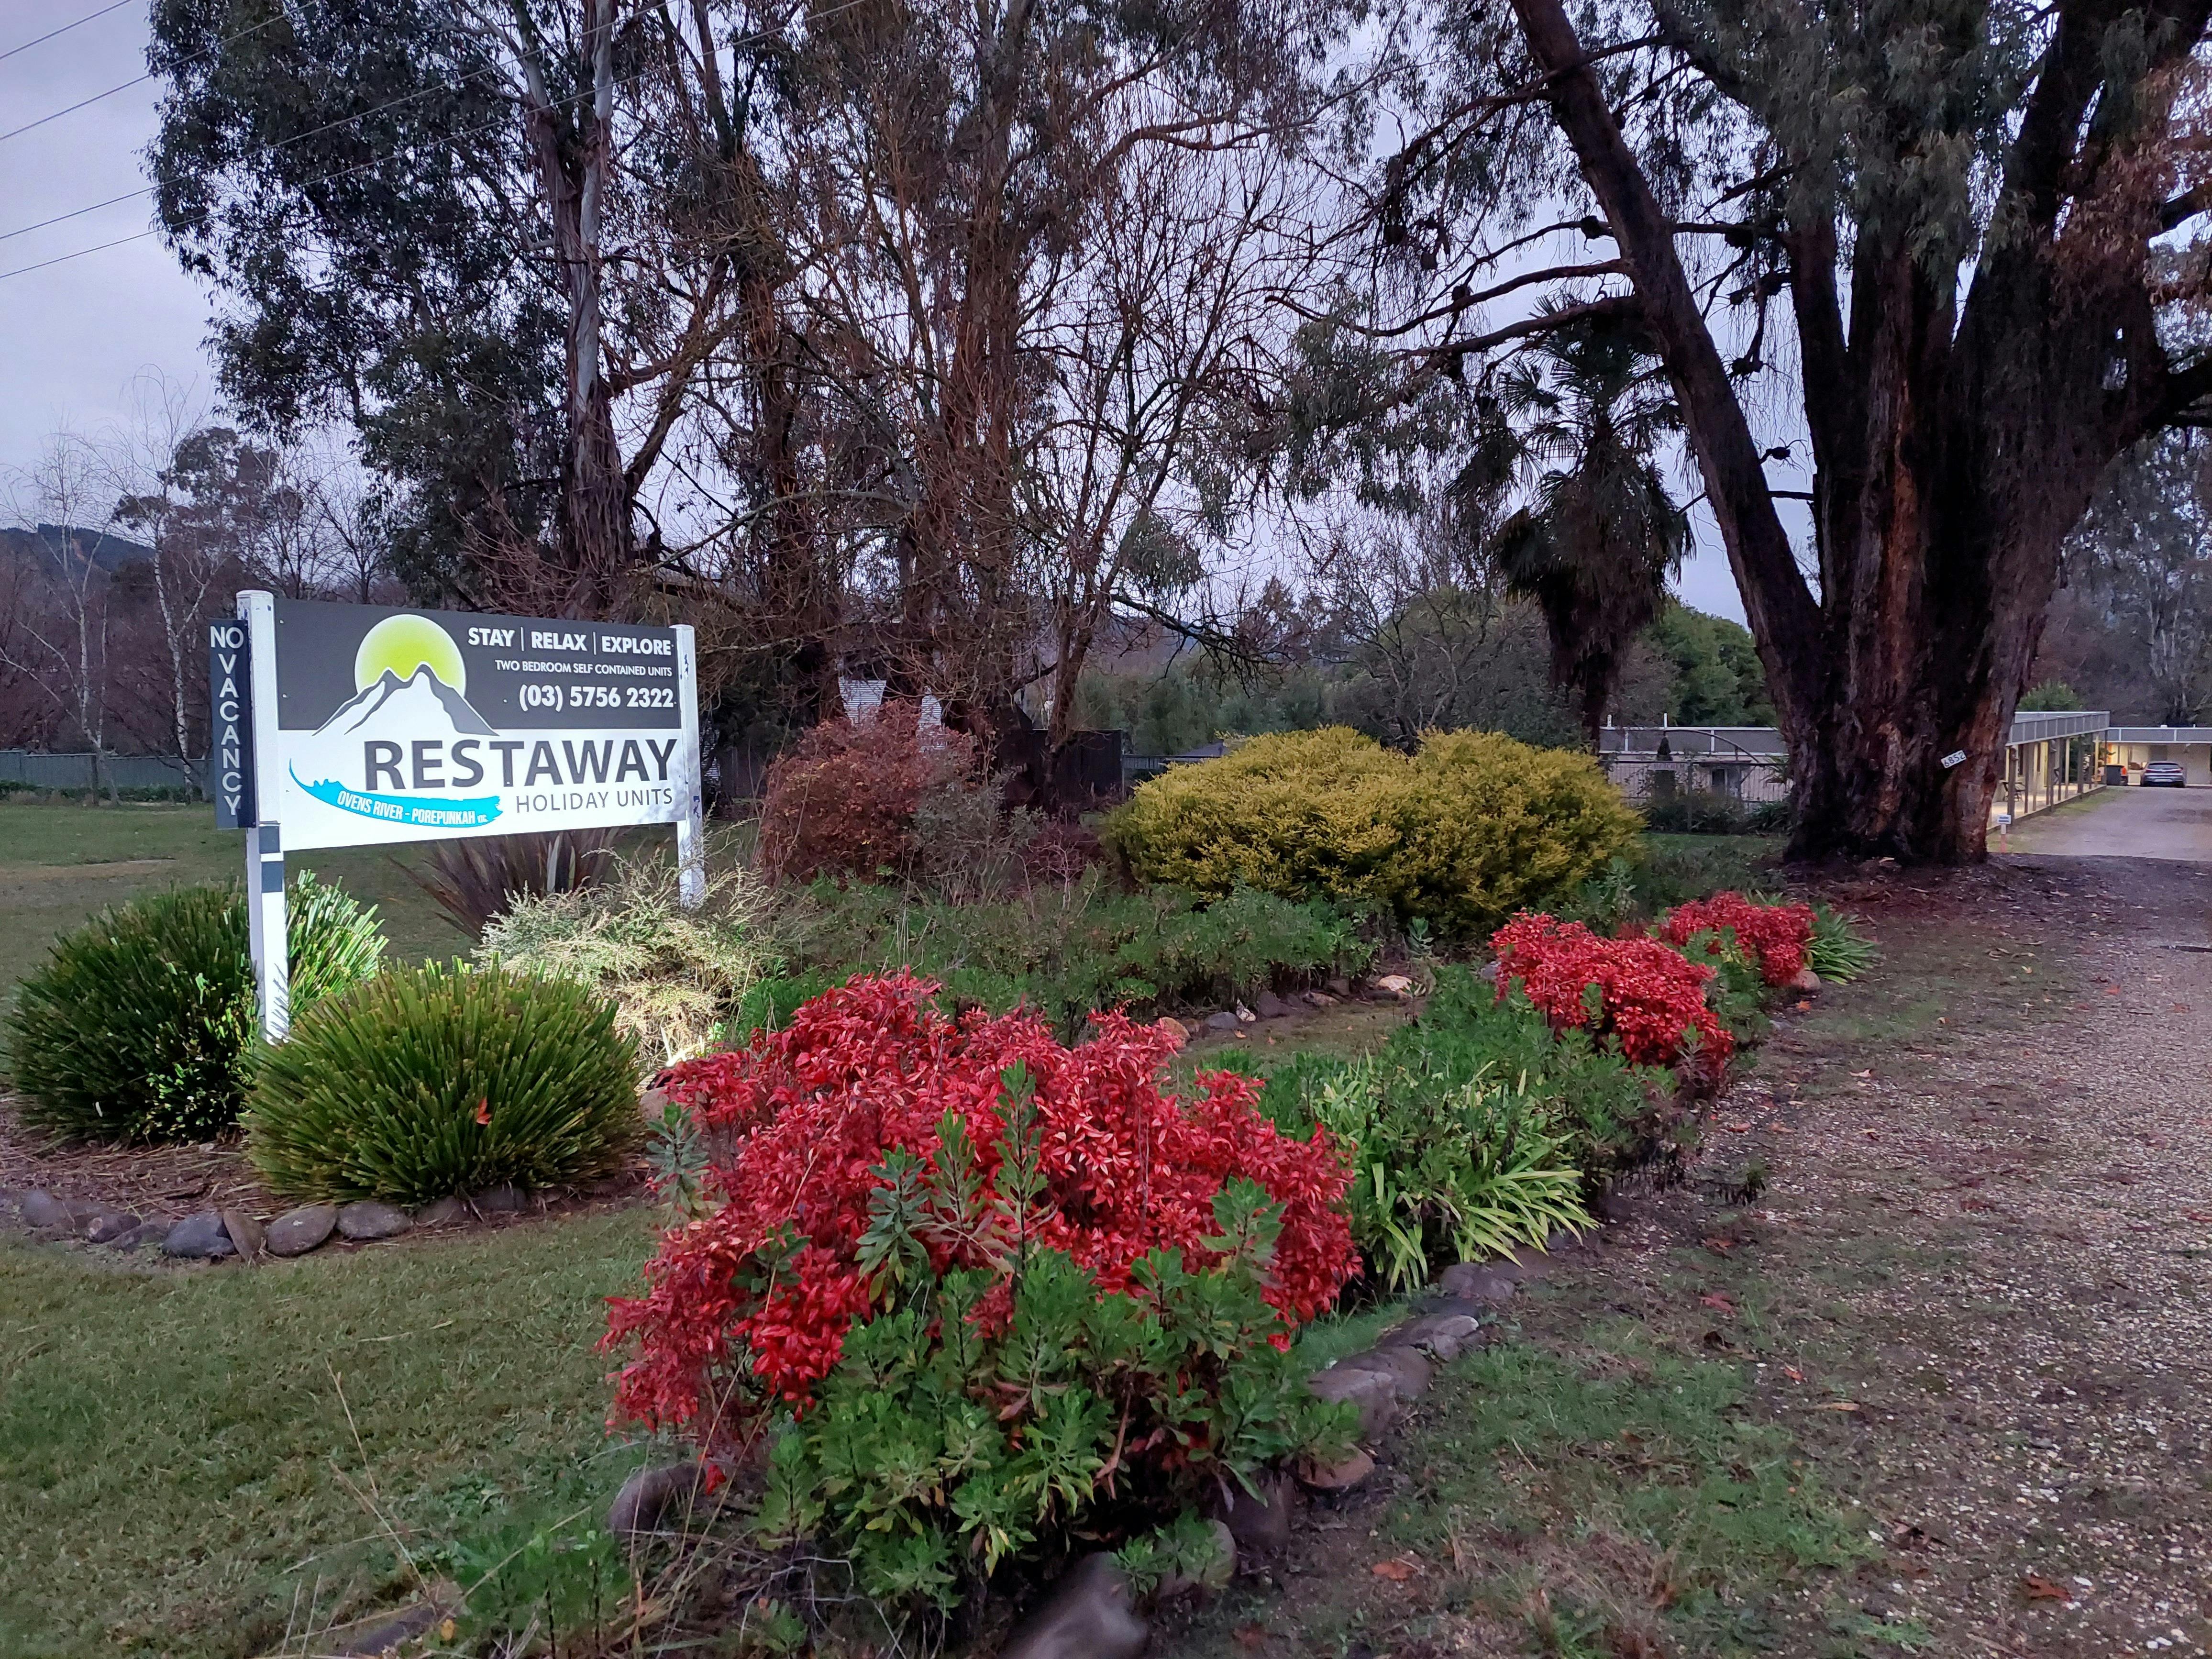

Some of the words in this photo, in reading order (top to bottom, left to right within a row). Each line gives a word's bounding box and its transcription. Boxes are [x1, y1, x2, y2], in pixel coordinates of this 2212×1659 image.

[210, 625, 243, 648] NO
[468, 627, 515, 647] STAY
[531, 631, 587, 652] RELAX
[601, 636, 672, 656] EXPLORE
[495, 660, 520, 671] TWO
[522, 661, 572, 673] BEDROOM
[573, 663, 593, 674] SELF
[595, 664, 646, 676] CONTAINED
[648, 667, 672, 676] UNITS
[519, 684, 563, 712] (03)
[570, 686, 621, 708] 5756
[626, 687, 674, 708] 2322
[218, 653, 242, 815] VACANCY
[364, 739, 678, 791] RESTAWAY
[1944, 752, 1965, 766] 6852
[337, 790, 372, 813] OVENS
[373, 801, 403, 820] RIVER
[411, 808, 476, 825] POREPUNKAH
[516, 791, 608, 813] HOLIDAY
[617, 788, 673, 807] UNITS
